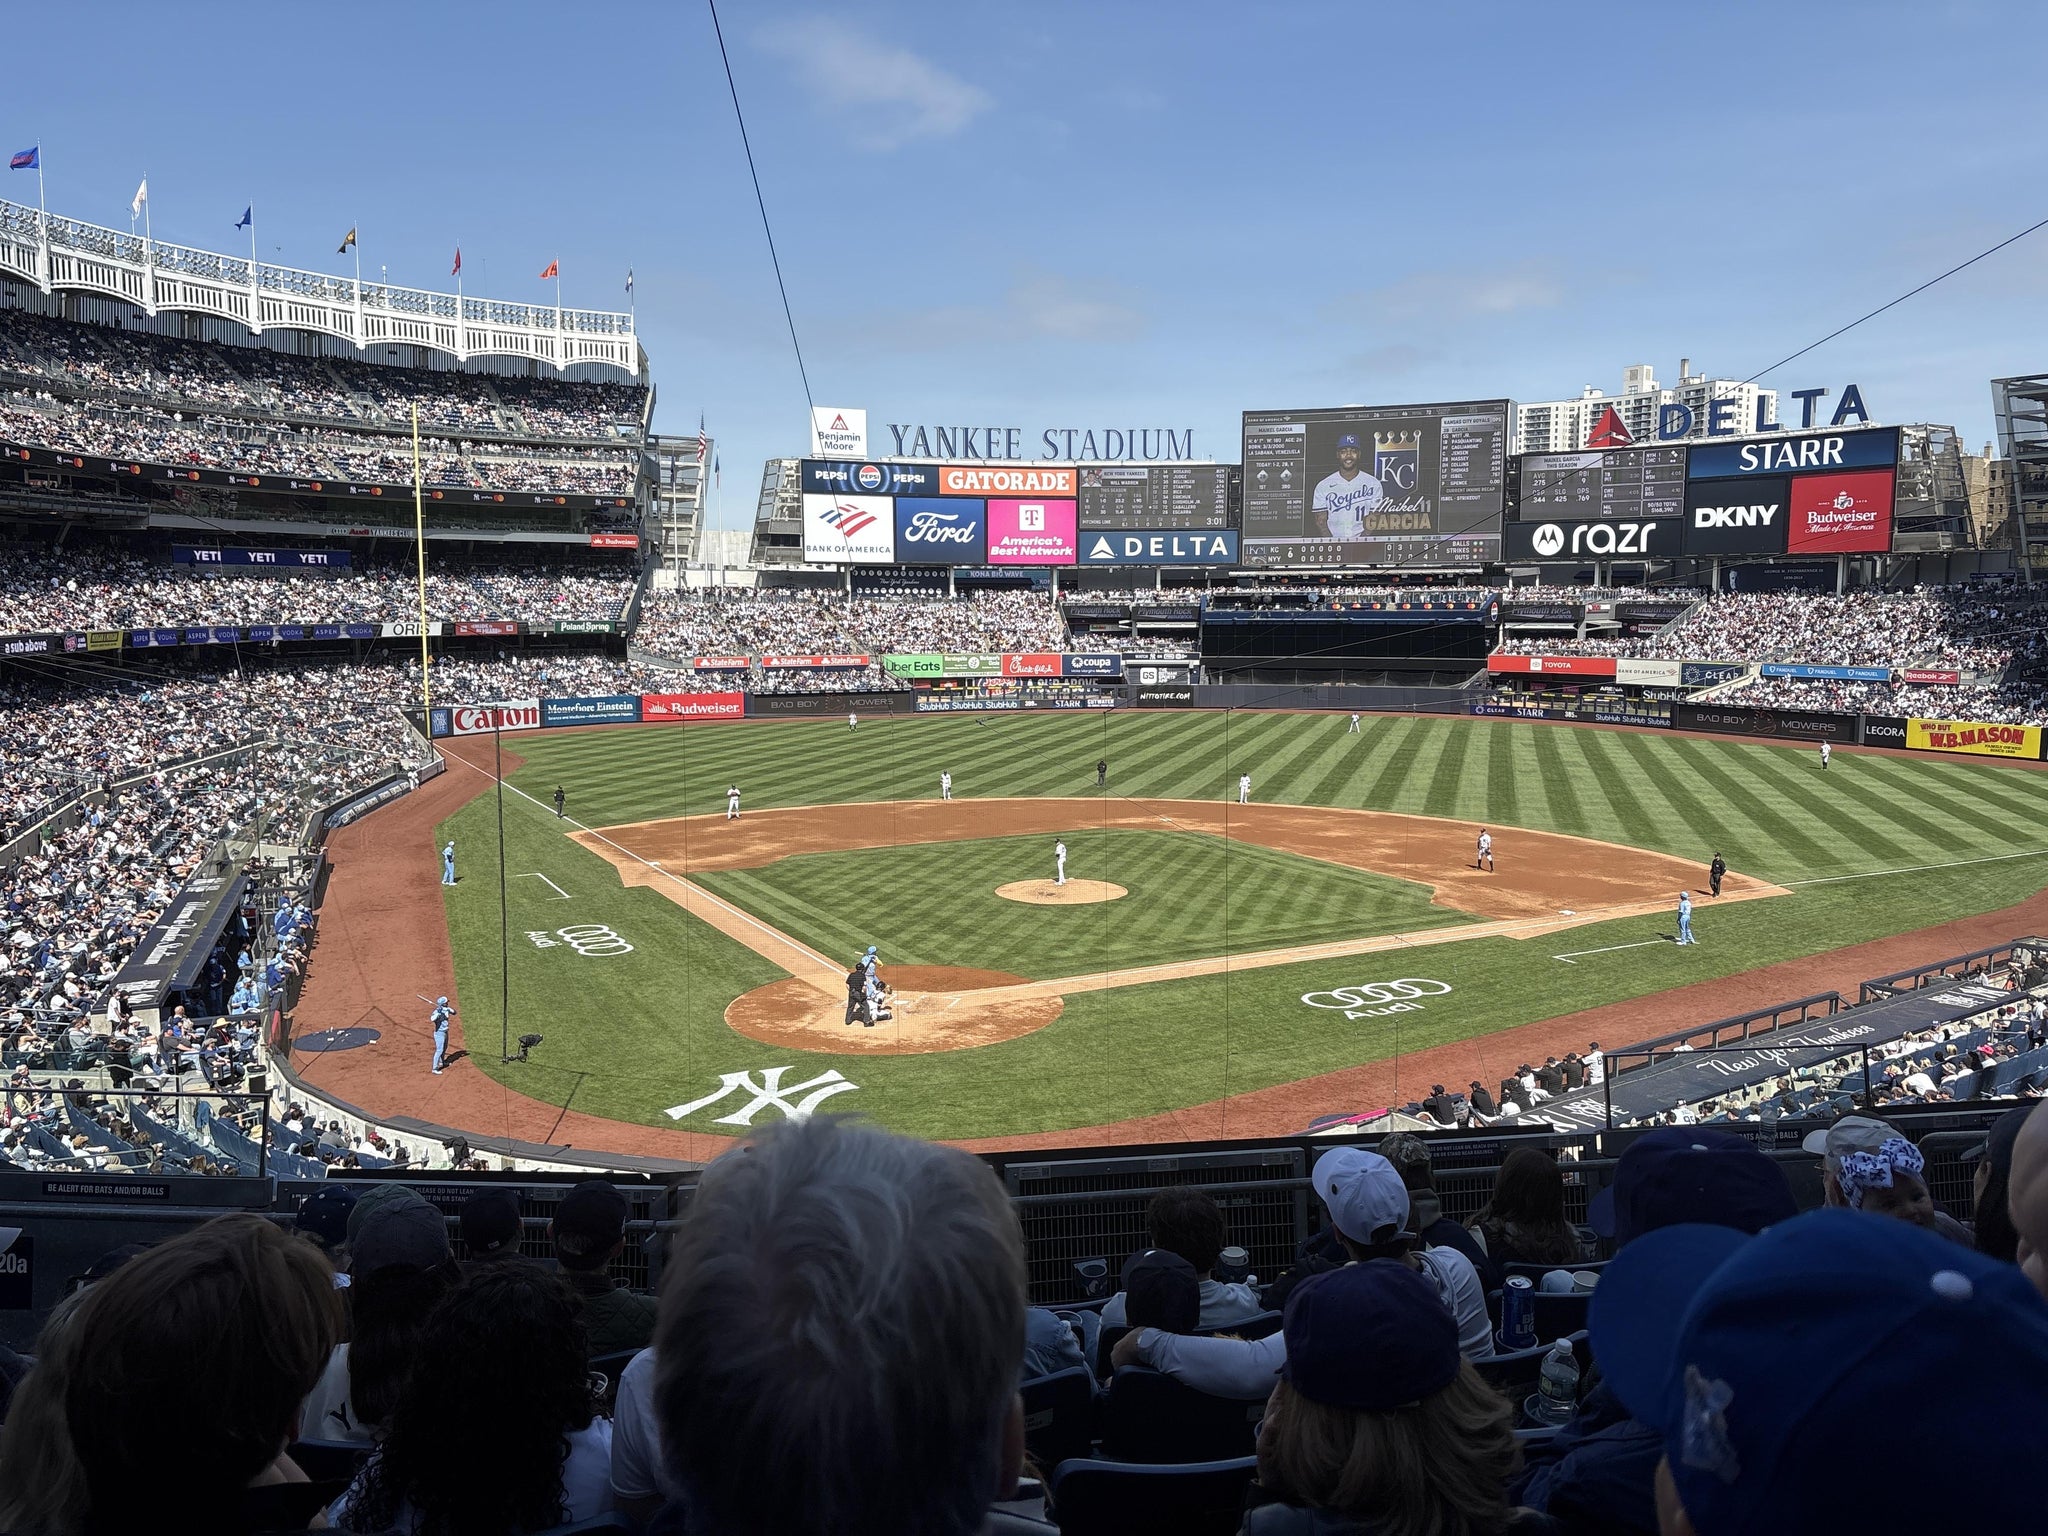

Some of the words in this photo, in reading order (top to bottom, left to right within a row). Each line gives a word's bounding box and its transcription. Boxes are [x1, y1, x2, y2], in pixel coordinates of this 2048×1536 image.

[1659, 384, 1869, 440] DELTA
[818, 431, 861, 442] Benjamin
[824, 441, 854, 451] Moore
[887, 424, 1022, 460] YANKEE
[1042, 428, 1195, 462] STADIUM
[1738, 437, 1844, 471] STARR
[815, 470, 848, 480] PEPSI
[893, 473, 925, 483] PEPSI
[947, 471, 1070, 491] GATORADE
[1325, 484, 1374, 511] Royals
[1373, 495, 1424, 513] Maikel
[1420, 499, 1431, 513] 11
[1694, 504, 1779, 528] DKNY
[1807, 509, 1877, 524] Budweiser
[1206, 517, 1222, 526] 3:01
[1365, 513, 1432, 531] GARCIA
[905, 511, 977, 543] Ford
[1805, 523, 1831, 534] Made
[371, 529, 398, 537] YANKEES
[1572, 522, 1657, 554] razr
[1000, 536, 1063, 546] America's
[806, 545, 832, 553] BANK
[990, 546, 1019, 556] Best
[1020, 546, 1074, 556] Network
[1124, 536, 1229, 557] DELTA
[193, 550, 221, 561] YETI
[248, 552, 275, 563] YETI
[299, 553, 328, 564] YETI
[1287, 550, 1294, 558] 6
[1070, 606, 1101, 614] Plymouth
[1138, 607, 1170, 615] Plymouth
[1171, 607, 1192, 615] Rock
[1511, 606, 1550, 615] Plymouth
[1551, 606, 1571, 614] Rock
[560, 622, 586, 632] Poland
[585, 622, 610, 632] Spring
[11, 639, 24, 653] sub
[24, 639, 48, 653] above
[885, 661, 913, 672] Uber
[914, 661, 941, 672] Eats
[1083, 658, 1111, 667] coupa
[1544, 661, 1572, 669] TOYOTA
[1142, 671, 1155, 679] GS
[1906, 672, 1937, 680] Reebok
[1139, 692, 1191, 700] NITTOTIRE.COM
[849, 698, 894, 706] MOWERS
[919, 702, 950, 711] StubHub
[951, 702, 983, 710] StubHub
[985, 701, 1018, 709] StubHub
[547, 704, 595, 714] Montefiore
[596, 701, 634, 712] Einstein
[671, 703, 740, 715] Budweiser
[1516, 708, 1544, 718] STARR
[1595, 713, 1621, 722] StubHub
[454, 706, 537, 731] Canon
[1622, 715, 1646, 724] StubHub
[1647, 717, 1672, 727] StubHub
[1696, 713, 1720, 724] BAD
[1723, 715, 1748, 726] BOY
[1781, 719, 1837, 732] MOWERS
[434, 724, 446, 732] LIFE
[1866, 725, 1906, 738] LEGORA
[1920, 723, 1936, 731] WHO
[1344, 1001, 1426, 1020] Audi
[1696, 1050, 1760, 1076] New
[1757, 1036, 1804, 1068] York
[1800, 1023, 1876, 1052] Yankees
[1779, 1130, 1799, 1139] BALLS
[47, 1183, 57, 1192] BE
[58, 1184, 79, 1193] ALERT
[80, 1184, 94, 1194] FOR
[94, 1184, 113, 1194] BATS
[113, 1185, 141, 1195] AND/OR
[142, 1186, 164, 1196] BALLS
